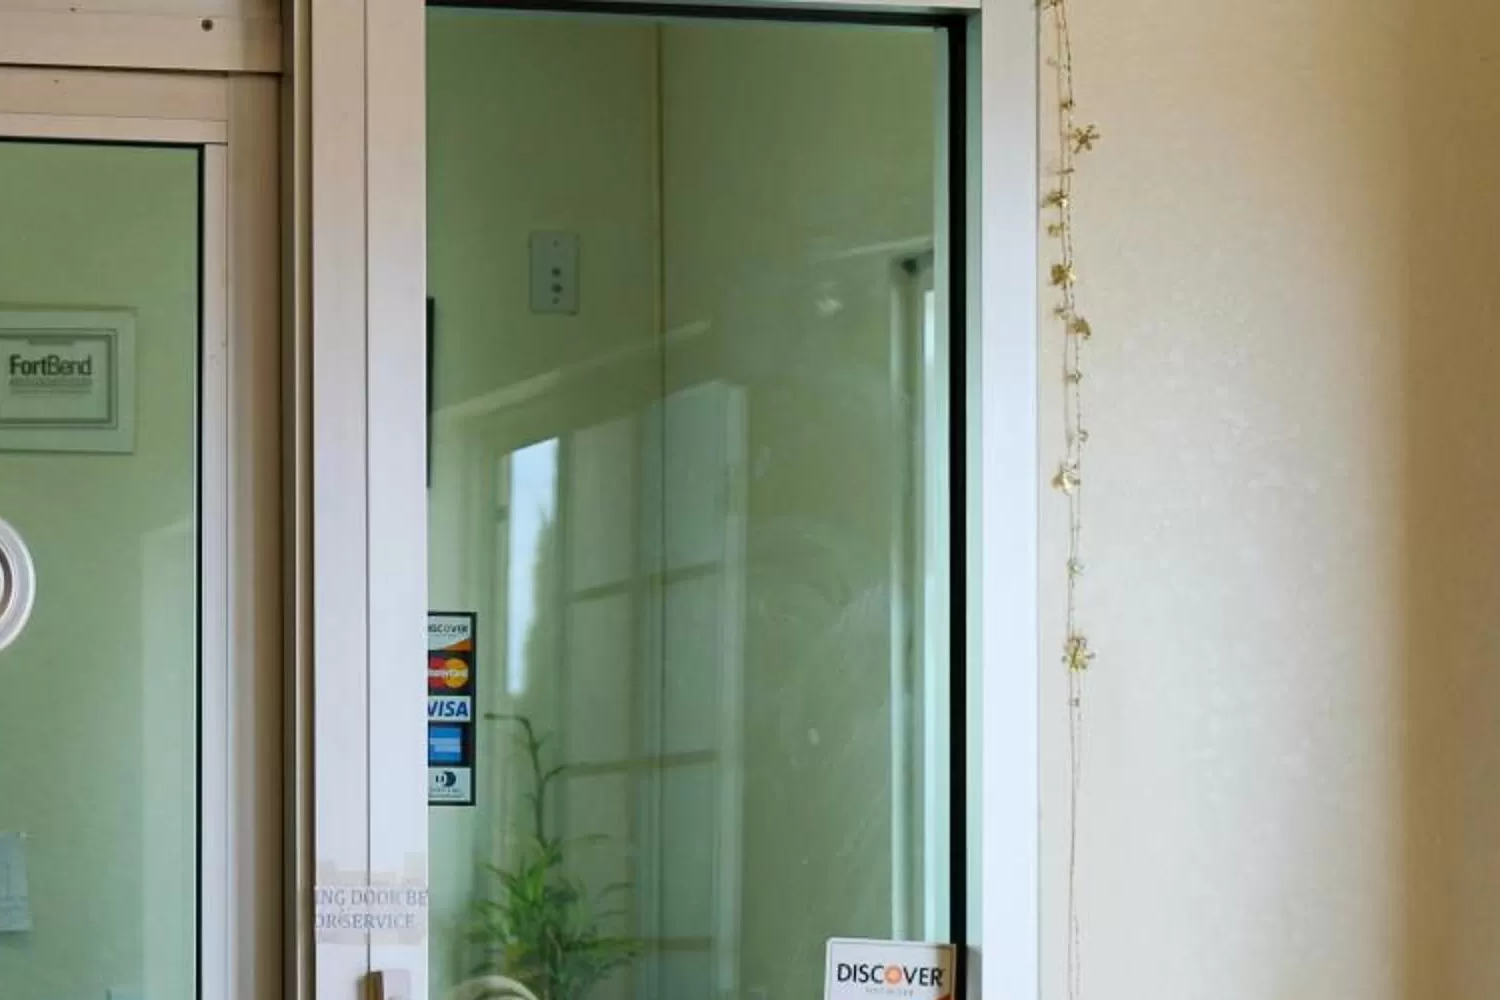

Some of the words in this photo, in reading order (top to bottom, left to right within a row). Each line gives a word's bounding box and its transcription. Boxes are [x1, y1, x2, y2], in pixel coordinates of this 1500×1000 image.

[9, 353, 93, 376] FortBend
[428, 700, 469, 717] VISA
[836, 962, 944, 988] DISCOVER
